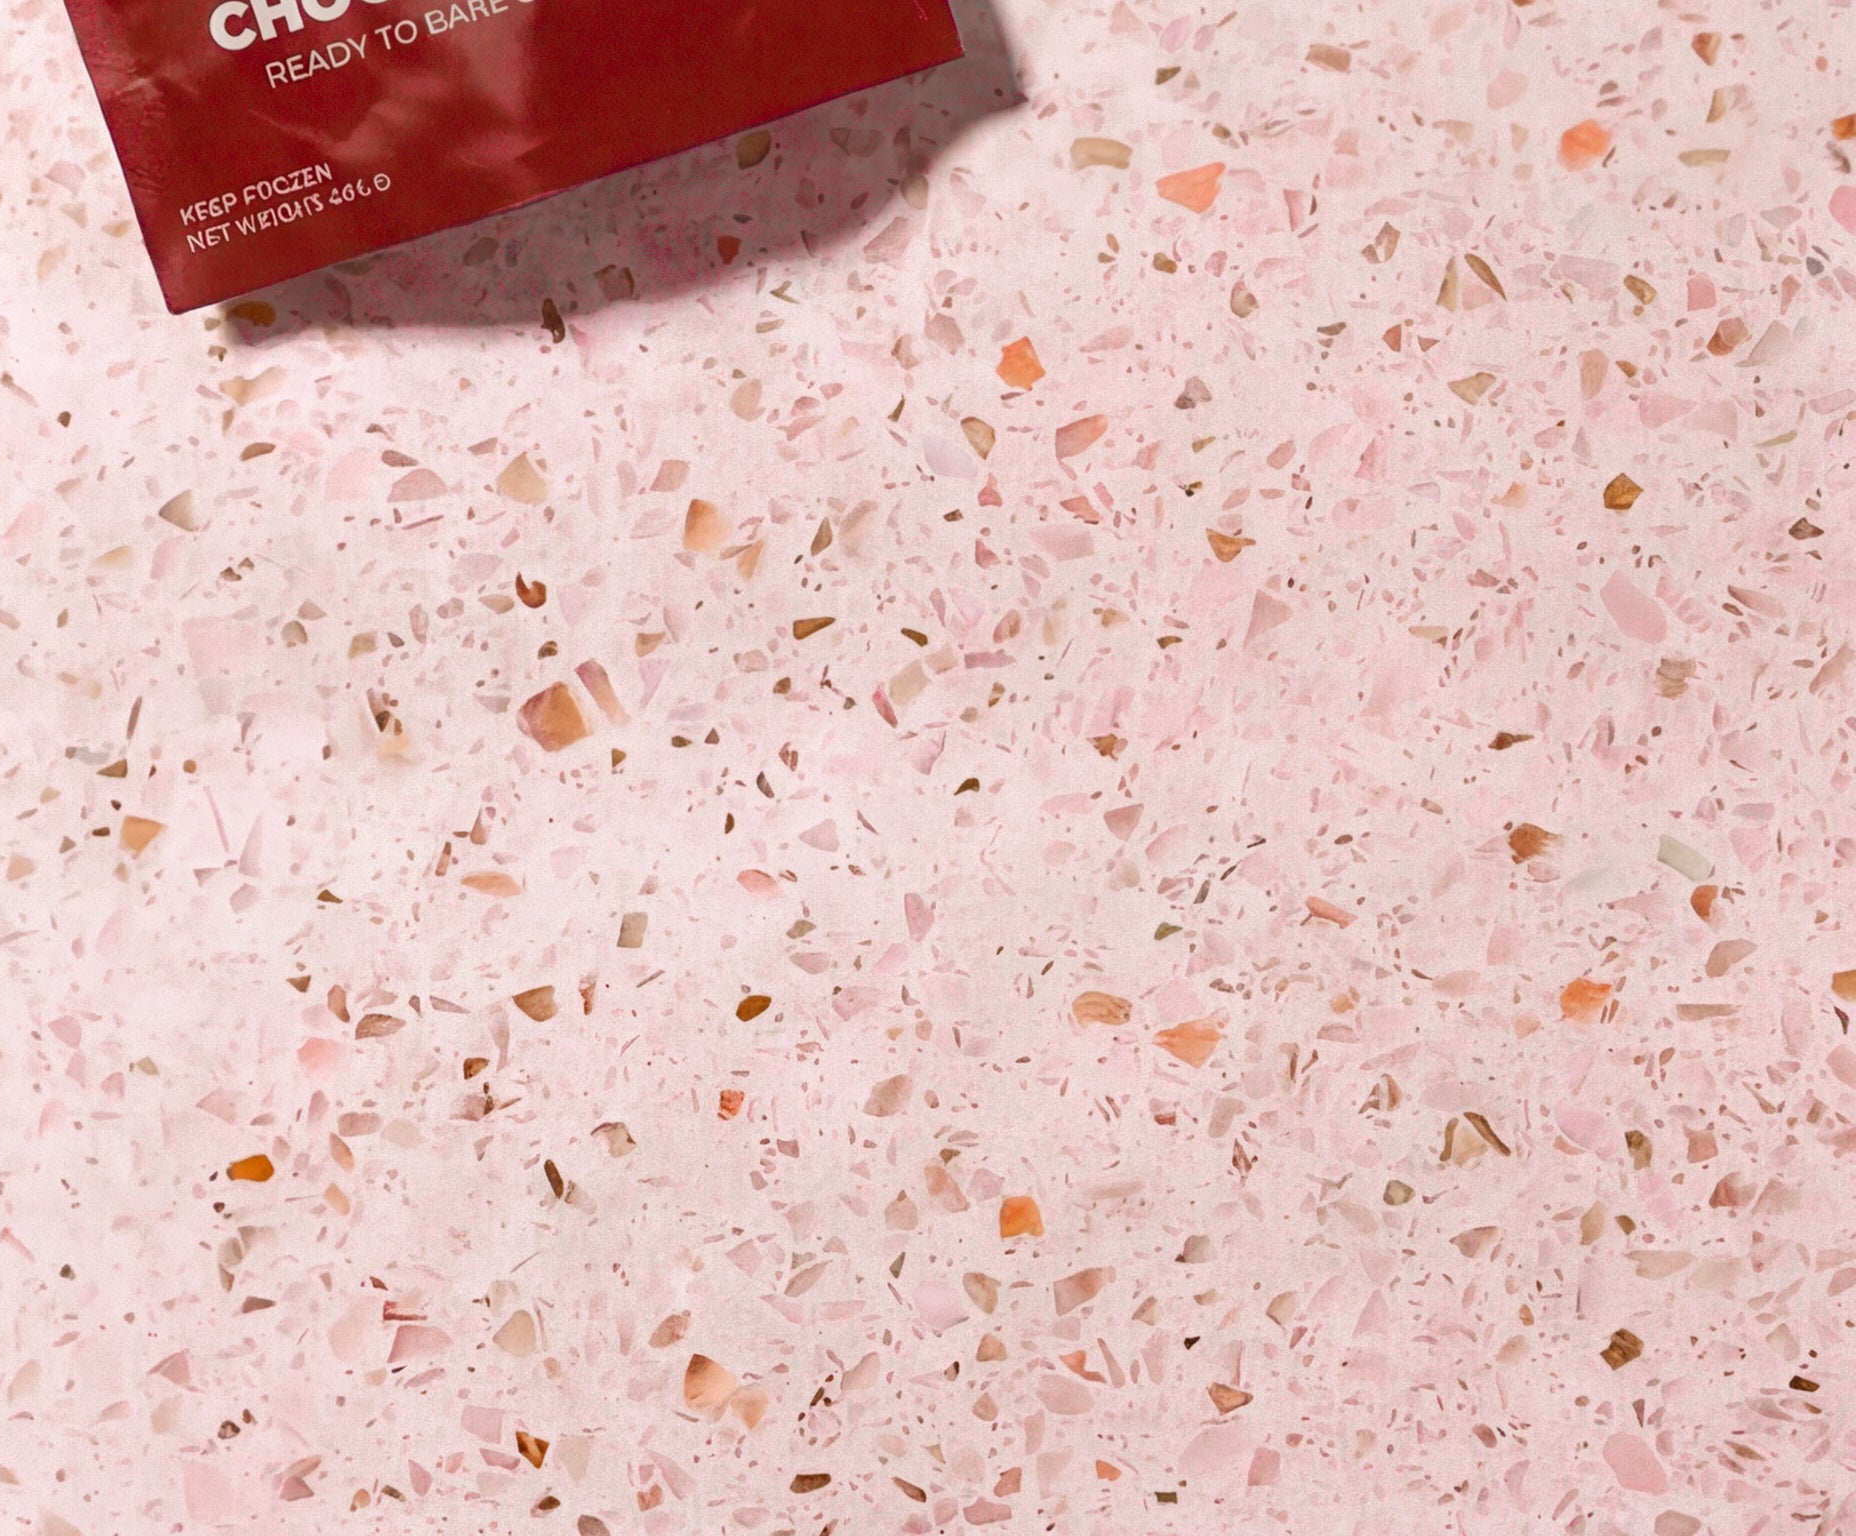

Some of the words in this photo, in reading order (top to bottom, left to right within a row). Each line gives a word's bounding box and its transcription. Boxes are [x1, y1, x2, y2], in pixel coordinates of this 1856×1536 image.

[264, 33, 368, 88] READY
[375, 19, 418, 50] TO
[186, 223, 232, 253] NET
